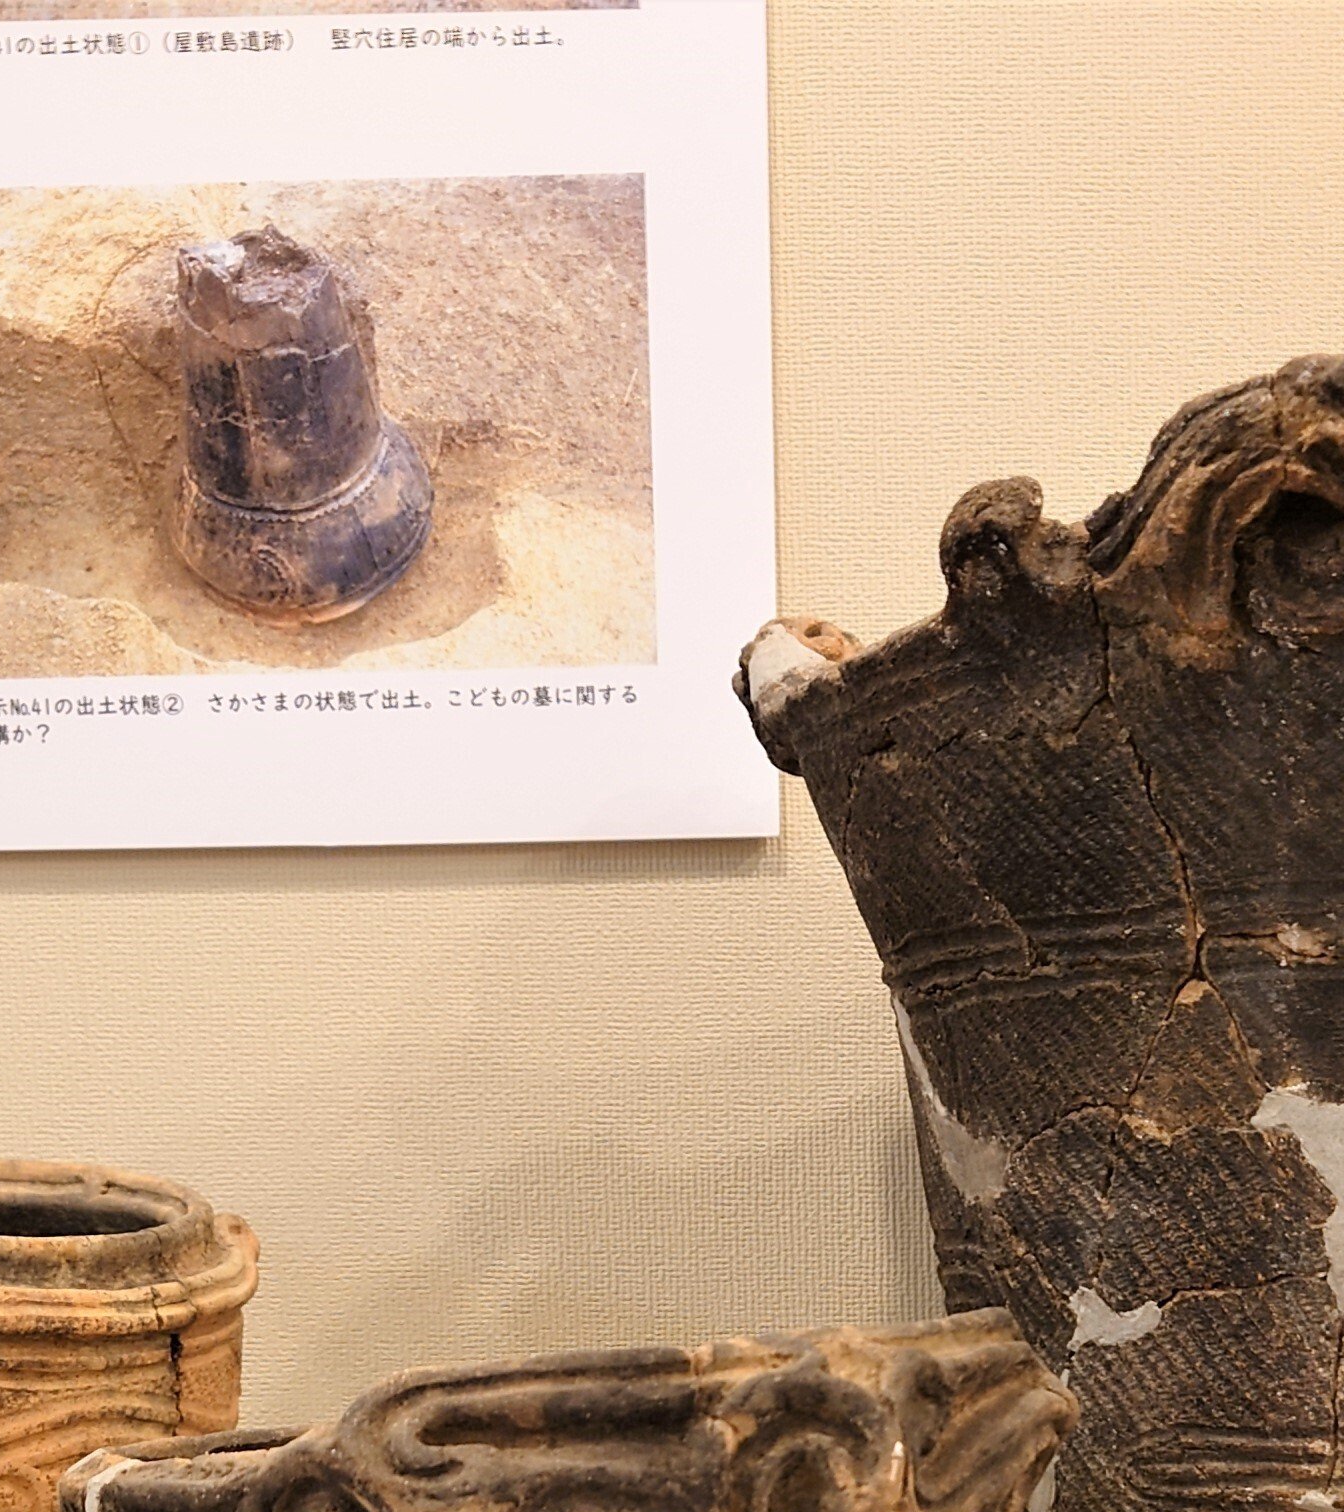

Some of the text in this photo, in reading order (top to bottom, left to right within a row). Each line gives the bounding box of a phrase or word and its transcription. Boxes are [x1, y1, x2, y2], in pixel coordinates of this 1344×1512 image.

[332, 26, 564, 51] 竪穴住居の端から出土。
